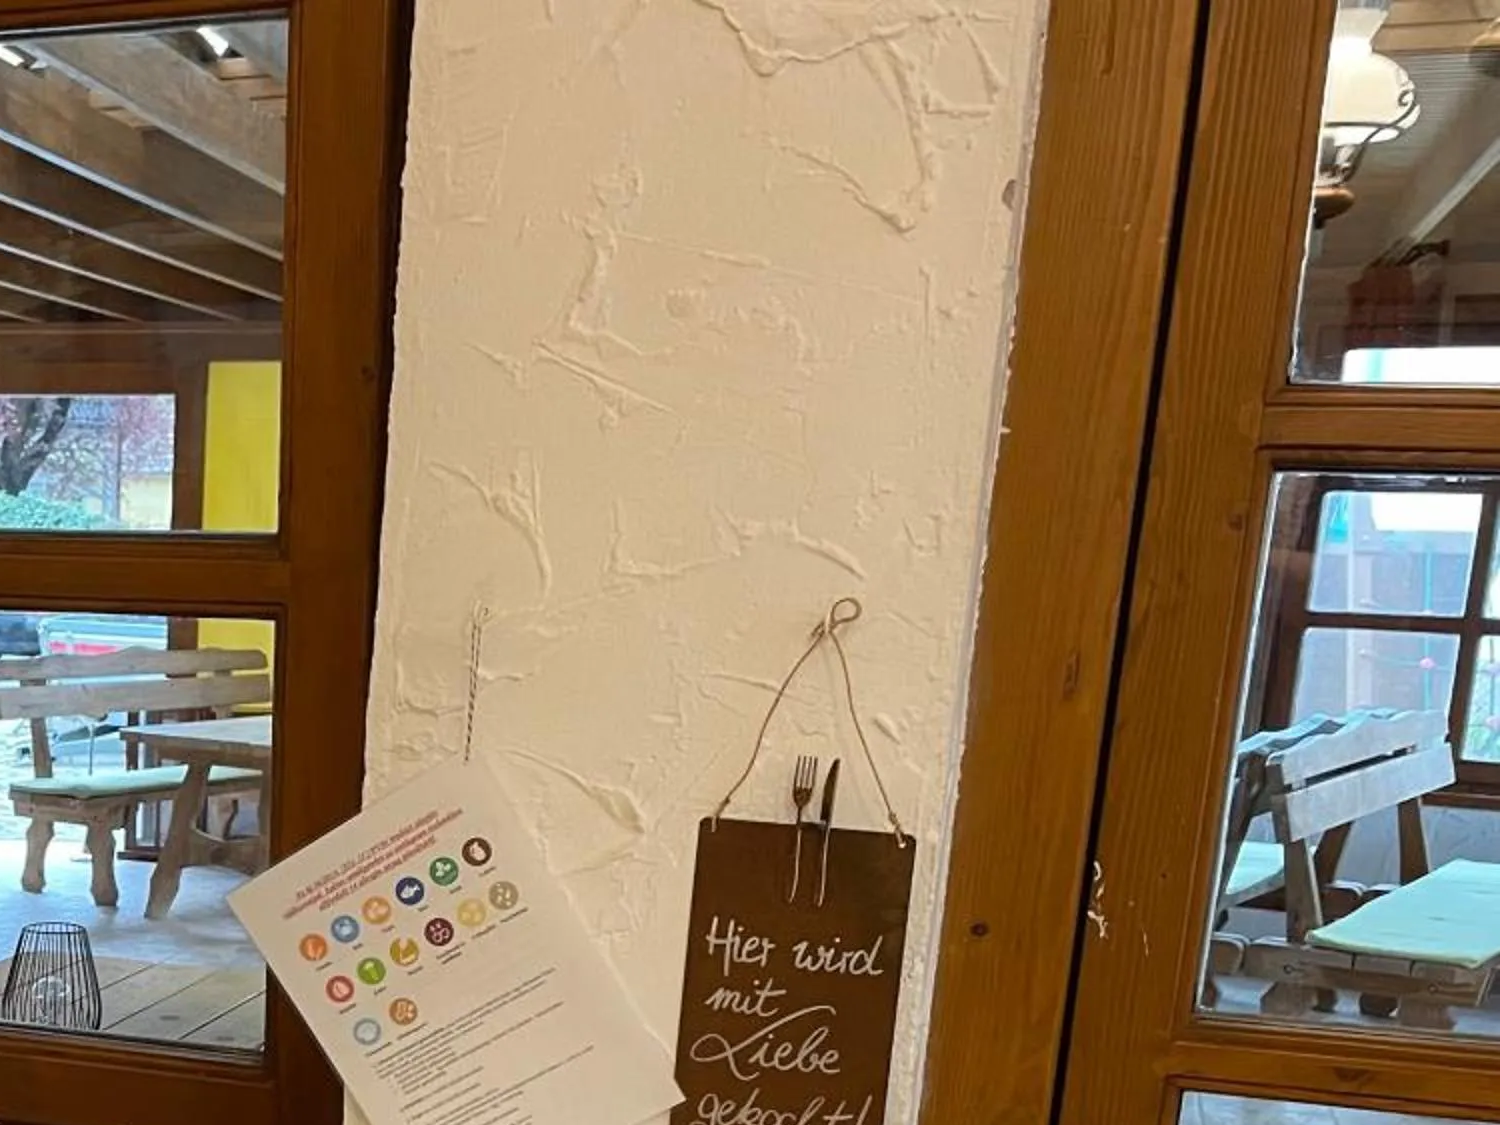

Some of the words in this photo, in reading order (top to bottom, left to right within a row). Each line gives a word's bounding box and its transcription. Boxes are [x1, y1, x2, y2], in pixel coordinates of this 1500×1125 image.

[706, 915, 776, 977] Hier
[792, 935, 884, 976] wird
[705, 979, 787, 1017] mit
[690, 1005, 841, 1081] Liebe
